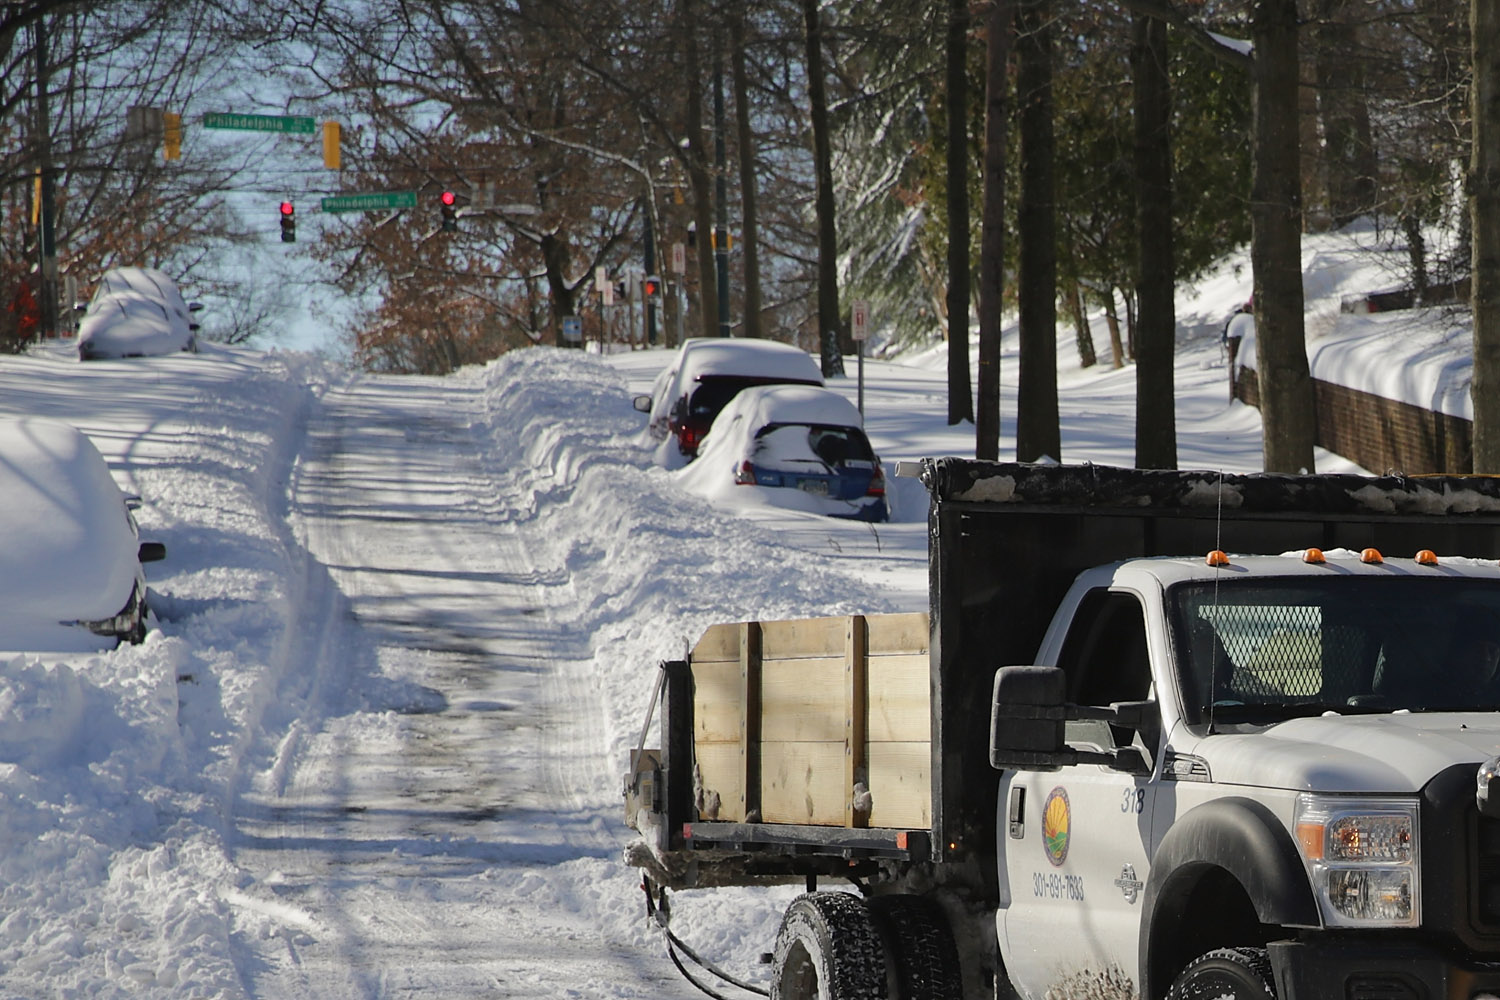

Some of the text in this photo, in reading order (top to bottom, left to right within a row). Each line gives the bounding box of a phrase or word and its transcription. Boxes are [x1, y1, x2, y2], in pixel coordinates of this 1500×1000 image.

[208, 115, 283, 131] Philadelphia
[1121, 787, 1145, 814] 318
[1033, 871, 1084, 901] 301-891-7633
